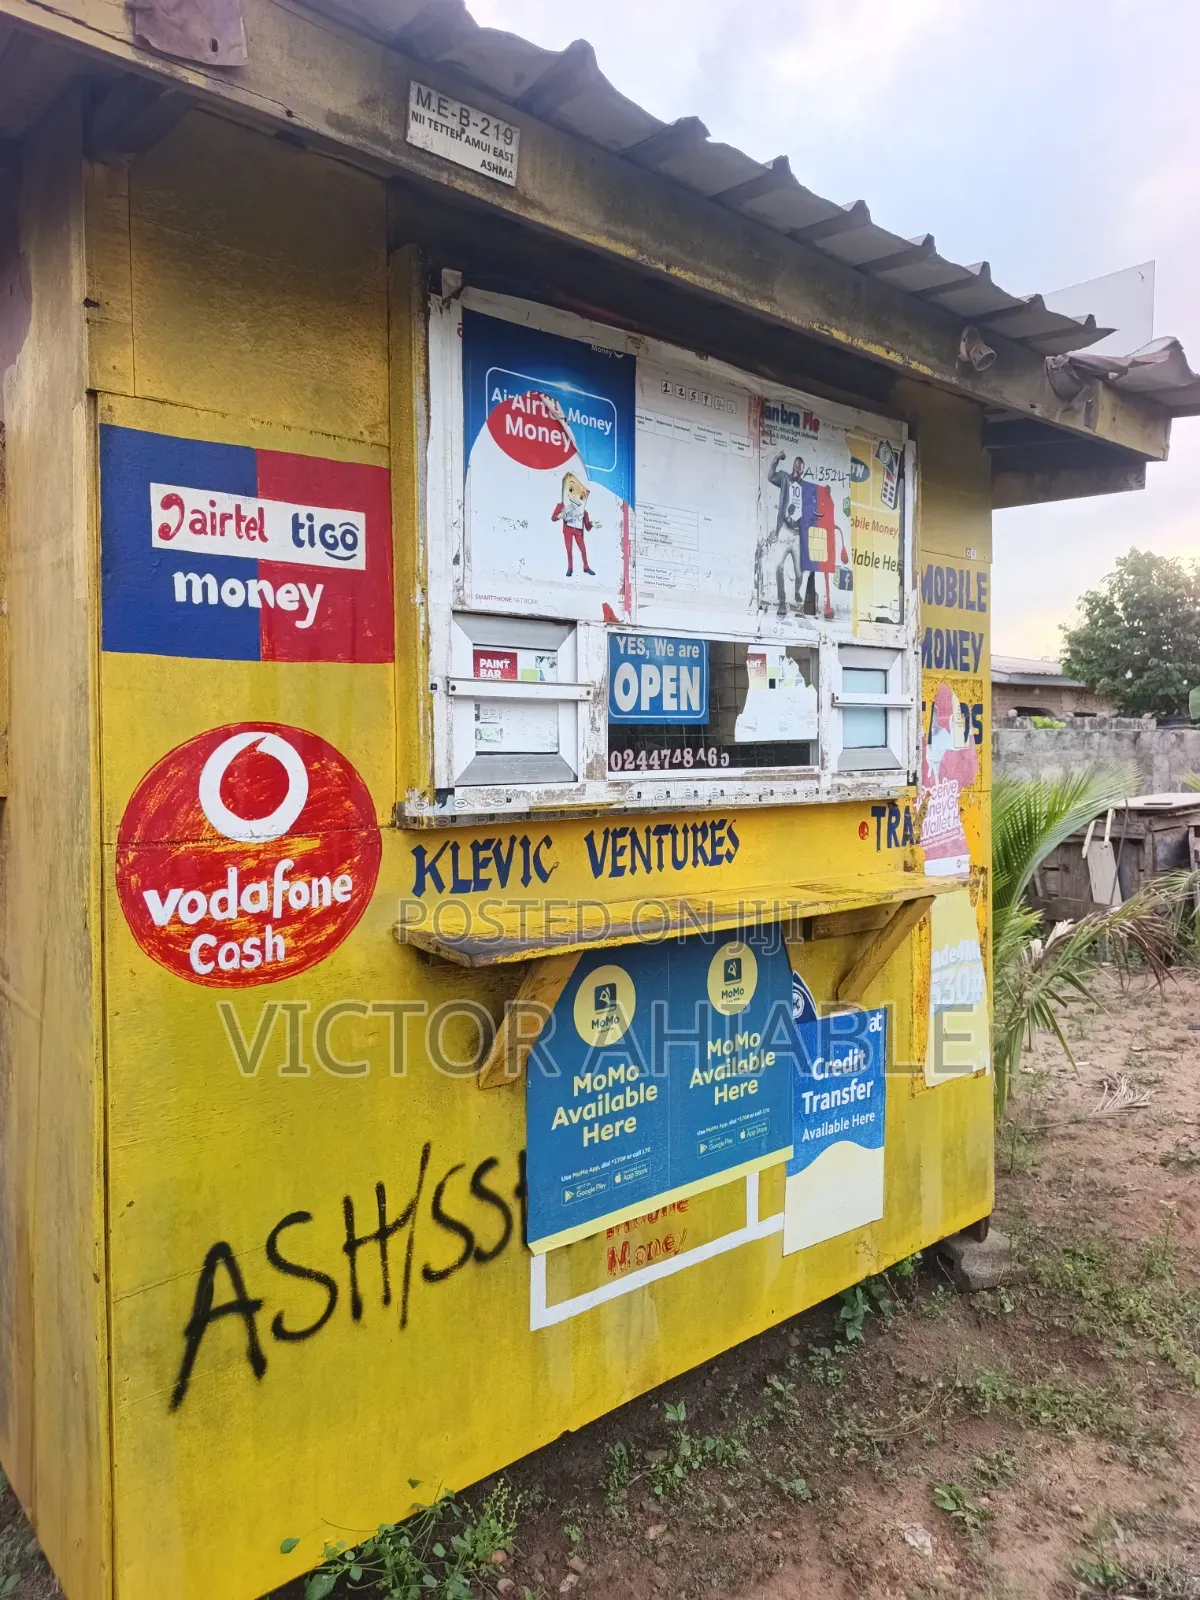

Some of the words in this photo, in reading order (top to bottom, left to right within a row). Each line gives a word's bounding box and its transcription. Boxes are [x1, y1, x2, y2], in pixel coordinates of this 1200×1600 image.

[411, 110, 426, 126] NII
[427, 117, 463, 143] TETTEH
[464, 134, 491, 155] AMUI
[492, 146, 514, 164] EAST
[505, 413, 571, 454] Money
[568, 407, 613, 436] Money
[791, 485, 801, 498] 10
[871, 519, 899, 540] Money
[172, 570, 325, 630] money
[921, 564, 988, 613] MOBILE
[616, 635, 650, 659] YES,
[654, 638, 675, 657] We
[678, 643, 700, 659] are
[921, 626, 985, 674] MONEY
[479, 657, 511, 670] PAINT
[479, 668, 502, 679] BAR
[613, 661, 701, 713] OPEN
[411, 834, 559, 900] KLEVIC
[583, 818, 740, 879] VENTURES
[722, 986, 745, 1000] MoMo
[591, 1015, 620, 1030] MoMo
[868, 1011, 883, 1033] at
[706, 1030, 761, 1060] MoMo
[574, 1062, 640, 1098] MoMo
[689, 1048, 776, 1089] Available
[812, 1048, 867, 1081] Credit
[551, 1082, 659, 1131] Available
[713, 1077, 759, 1106] Here
[801, 1077, 875, 1115] Transfer
[582, 1115, 638, 1148] Here
[801, 1116, 850, 1143] Available
[851, 1111, 876, 1128] Here
[561, 1174, 572, 1182] Use
[572, 1168, 589, 1178] MoMo
[600, 1160, 611, 1169] dial
[632, 1149, 642, 1158] call
[623, 1173, 635, 1182] App
[634, 1167, 649, 1178] Store
[576, 1185, 596, 1198] Google
[595, 1182, 607, 1192] Play
